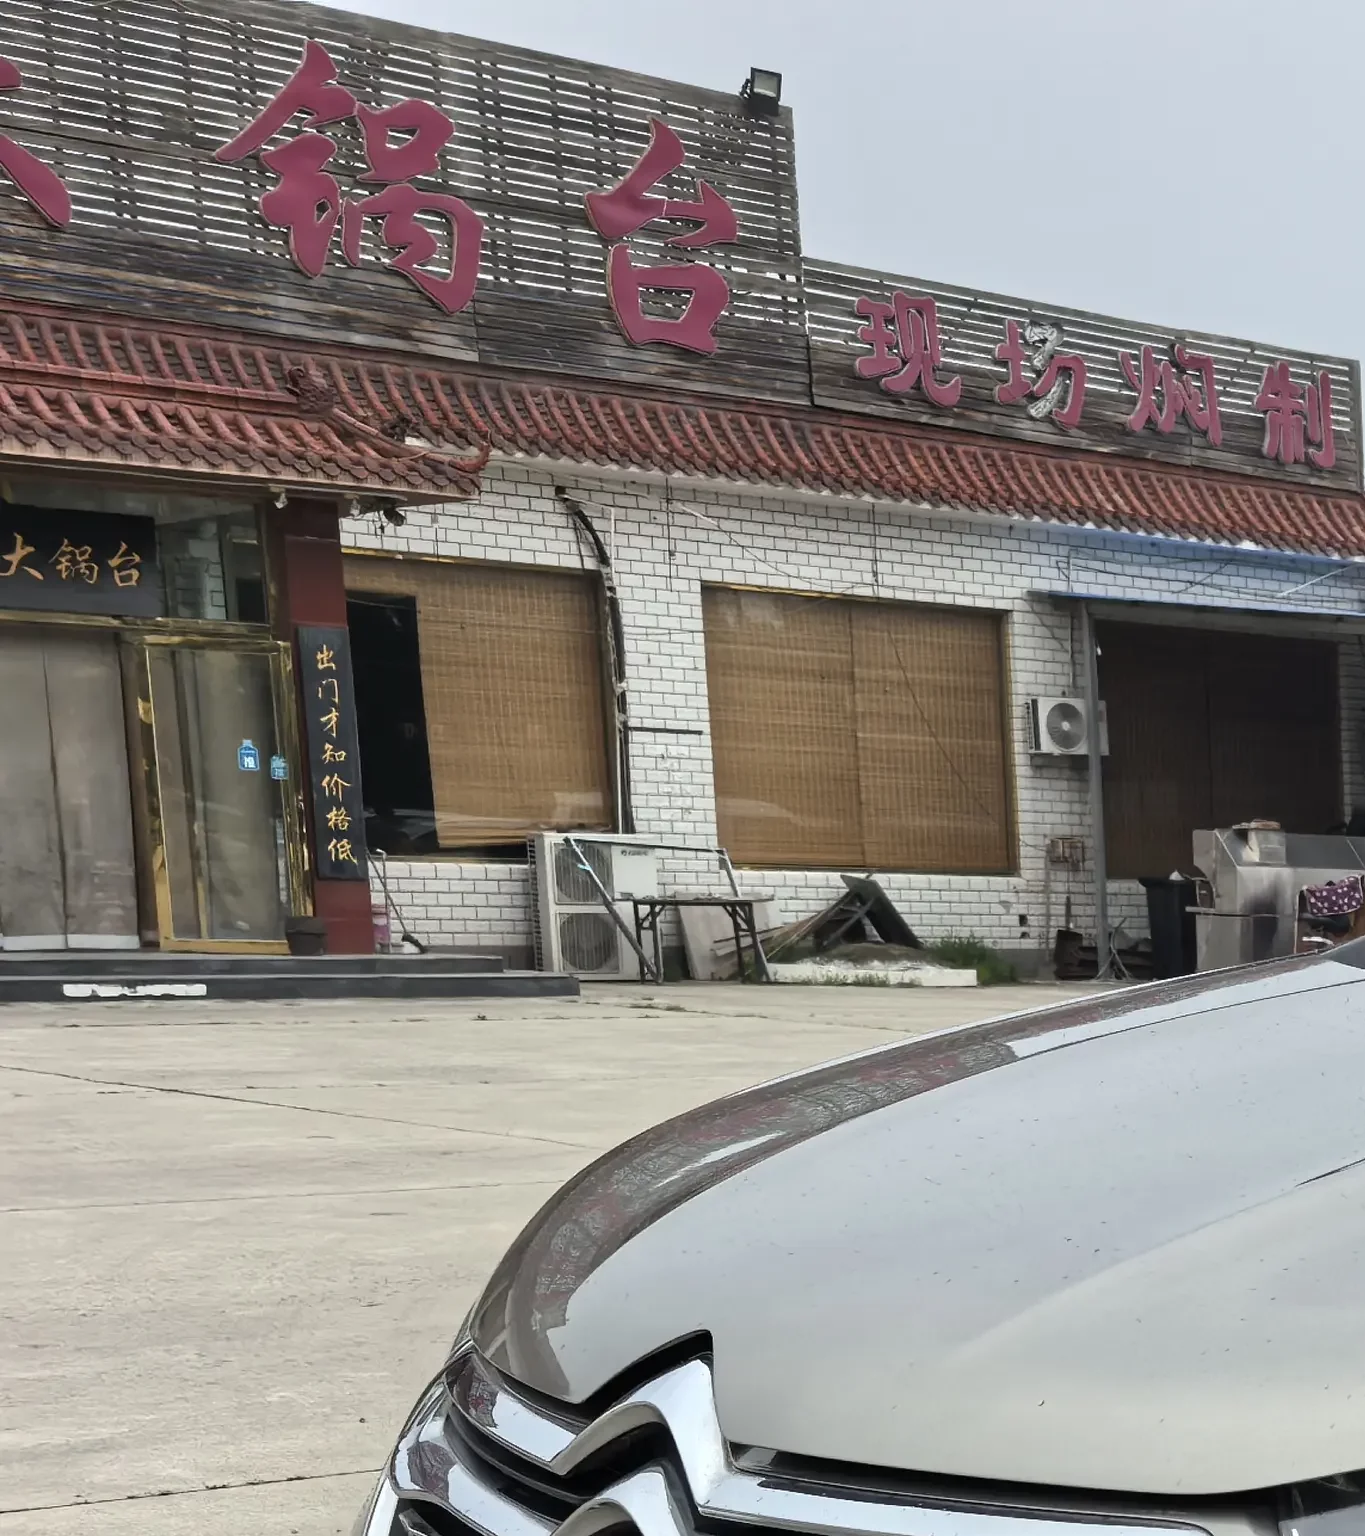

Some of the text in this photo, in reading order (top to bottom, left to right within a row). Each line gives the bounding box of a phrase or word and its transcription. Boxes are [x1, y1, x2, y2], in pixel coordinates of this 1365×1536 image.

[855, 290, 1336, 469] 现场焖制
[0, 532, 142, 587] 大锅台
[316, 644, 358, 865] 出门才知价格低
